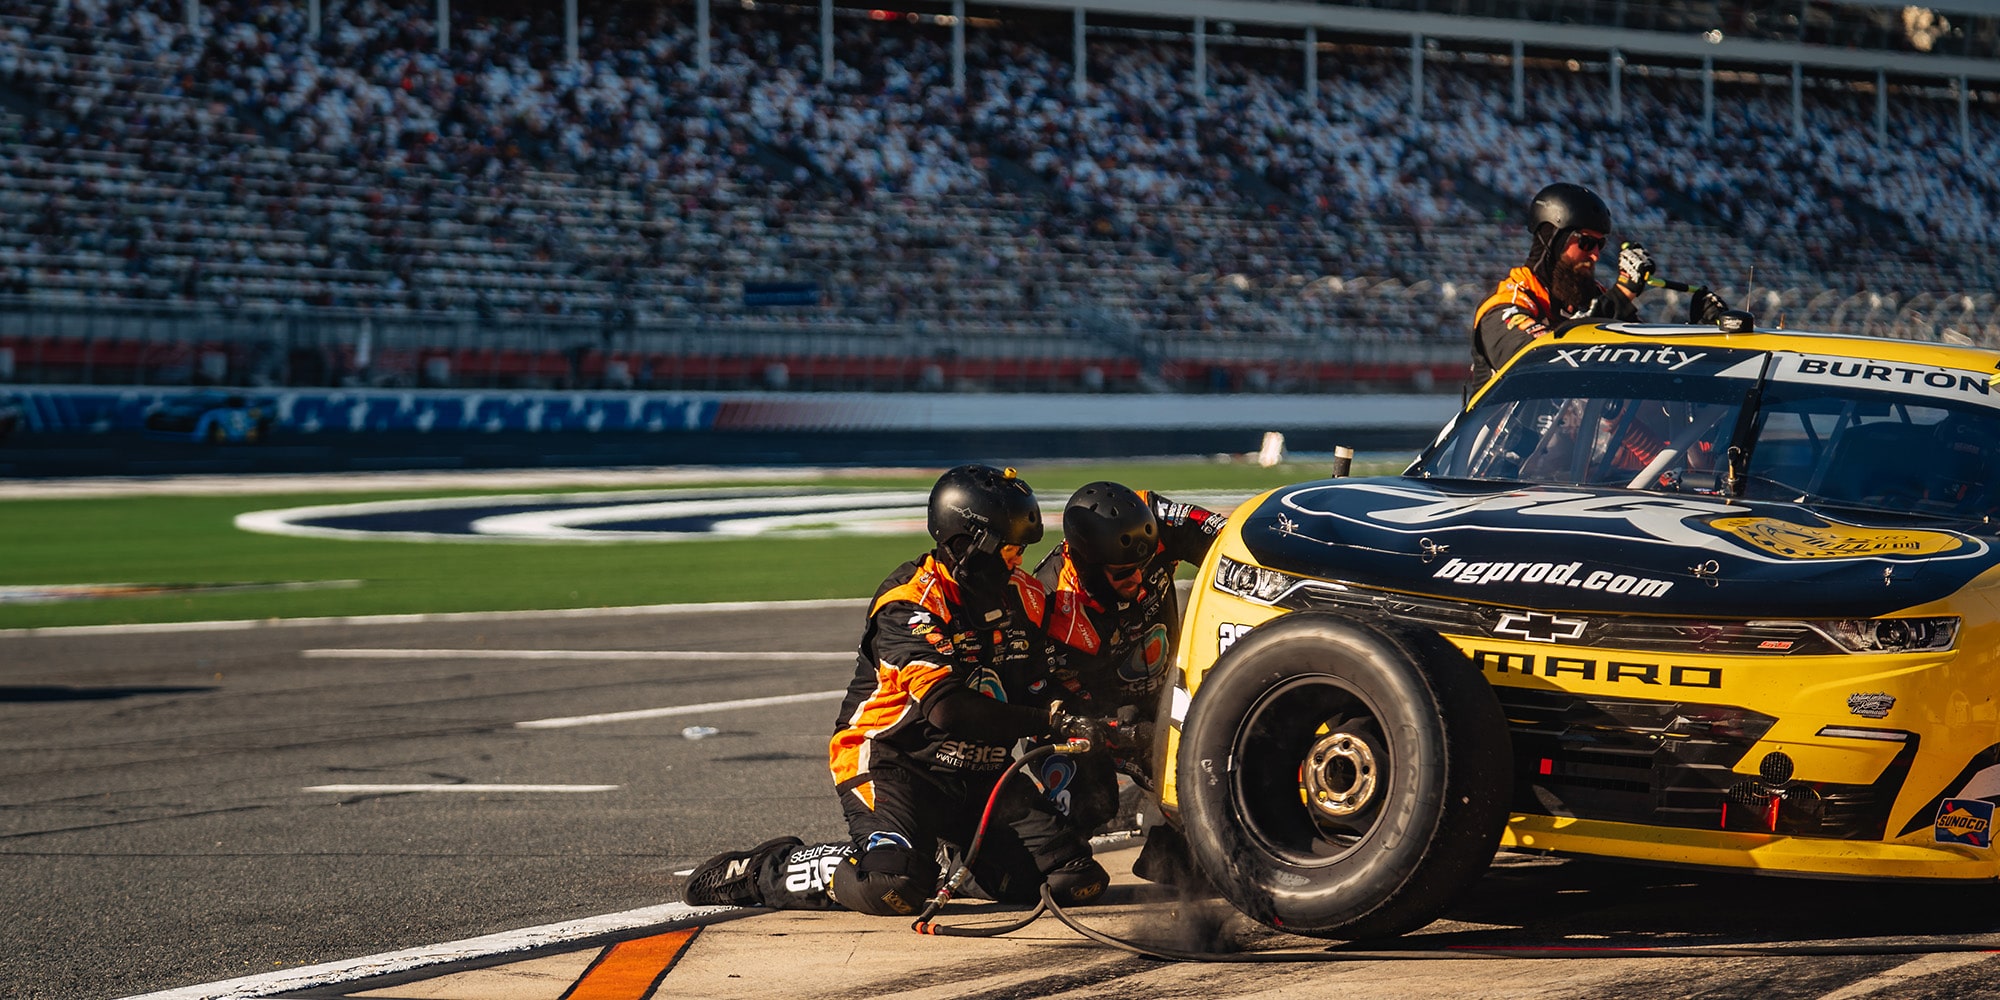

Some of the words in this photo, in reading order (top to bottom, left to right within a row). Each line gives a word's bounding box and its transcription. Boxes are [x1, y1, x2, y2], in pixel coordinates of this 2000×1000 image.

[1548, 344, 1708, 372] xfinity
[1797, 358, 1990, 397] BURTON
[1432, 558, 1674, 598] bgprod.com
[1472, 649, 1723, 689] MARO
[938, 740, 1007, 763] state
[1939, 815, 1986, 831] SUNOCO
